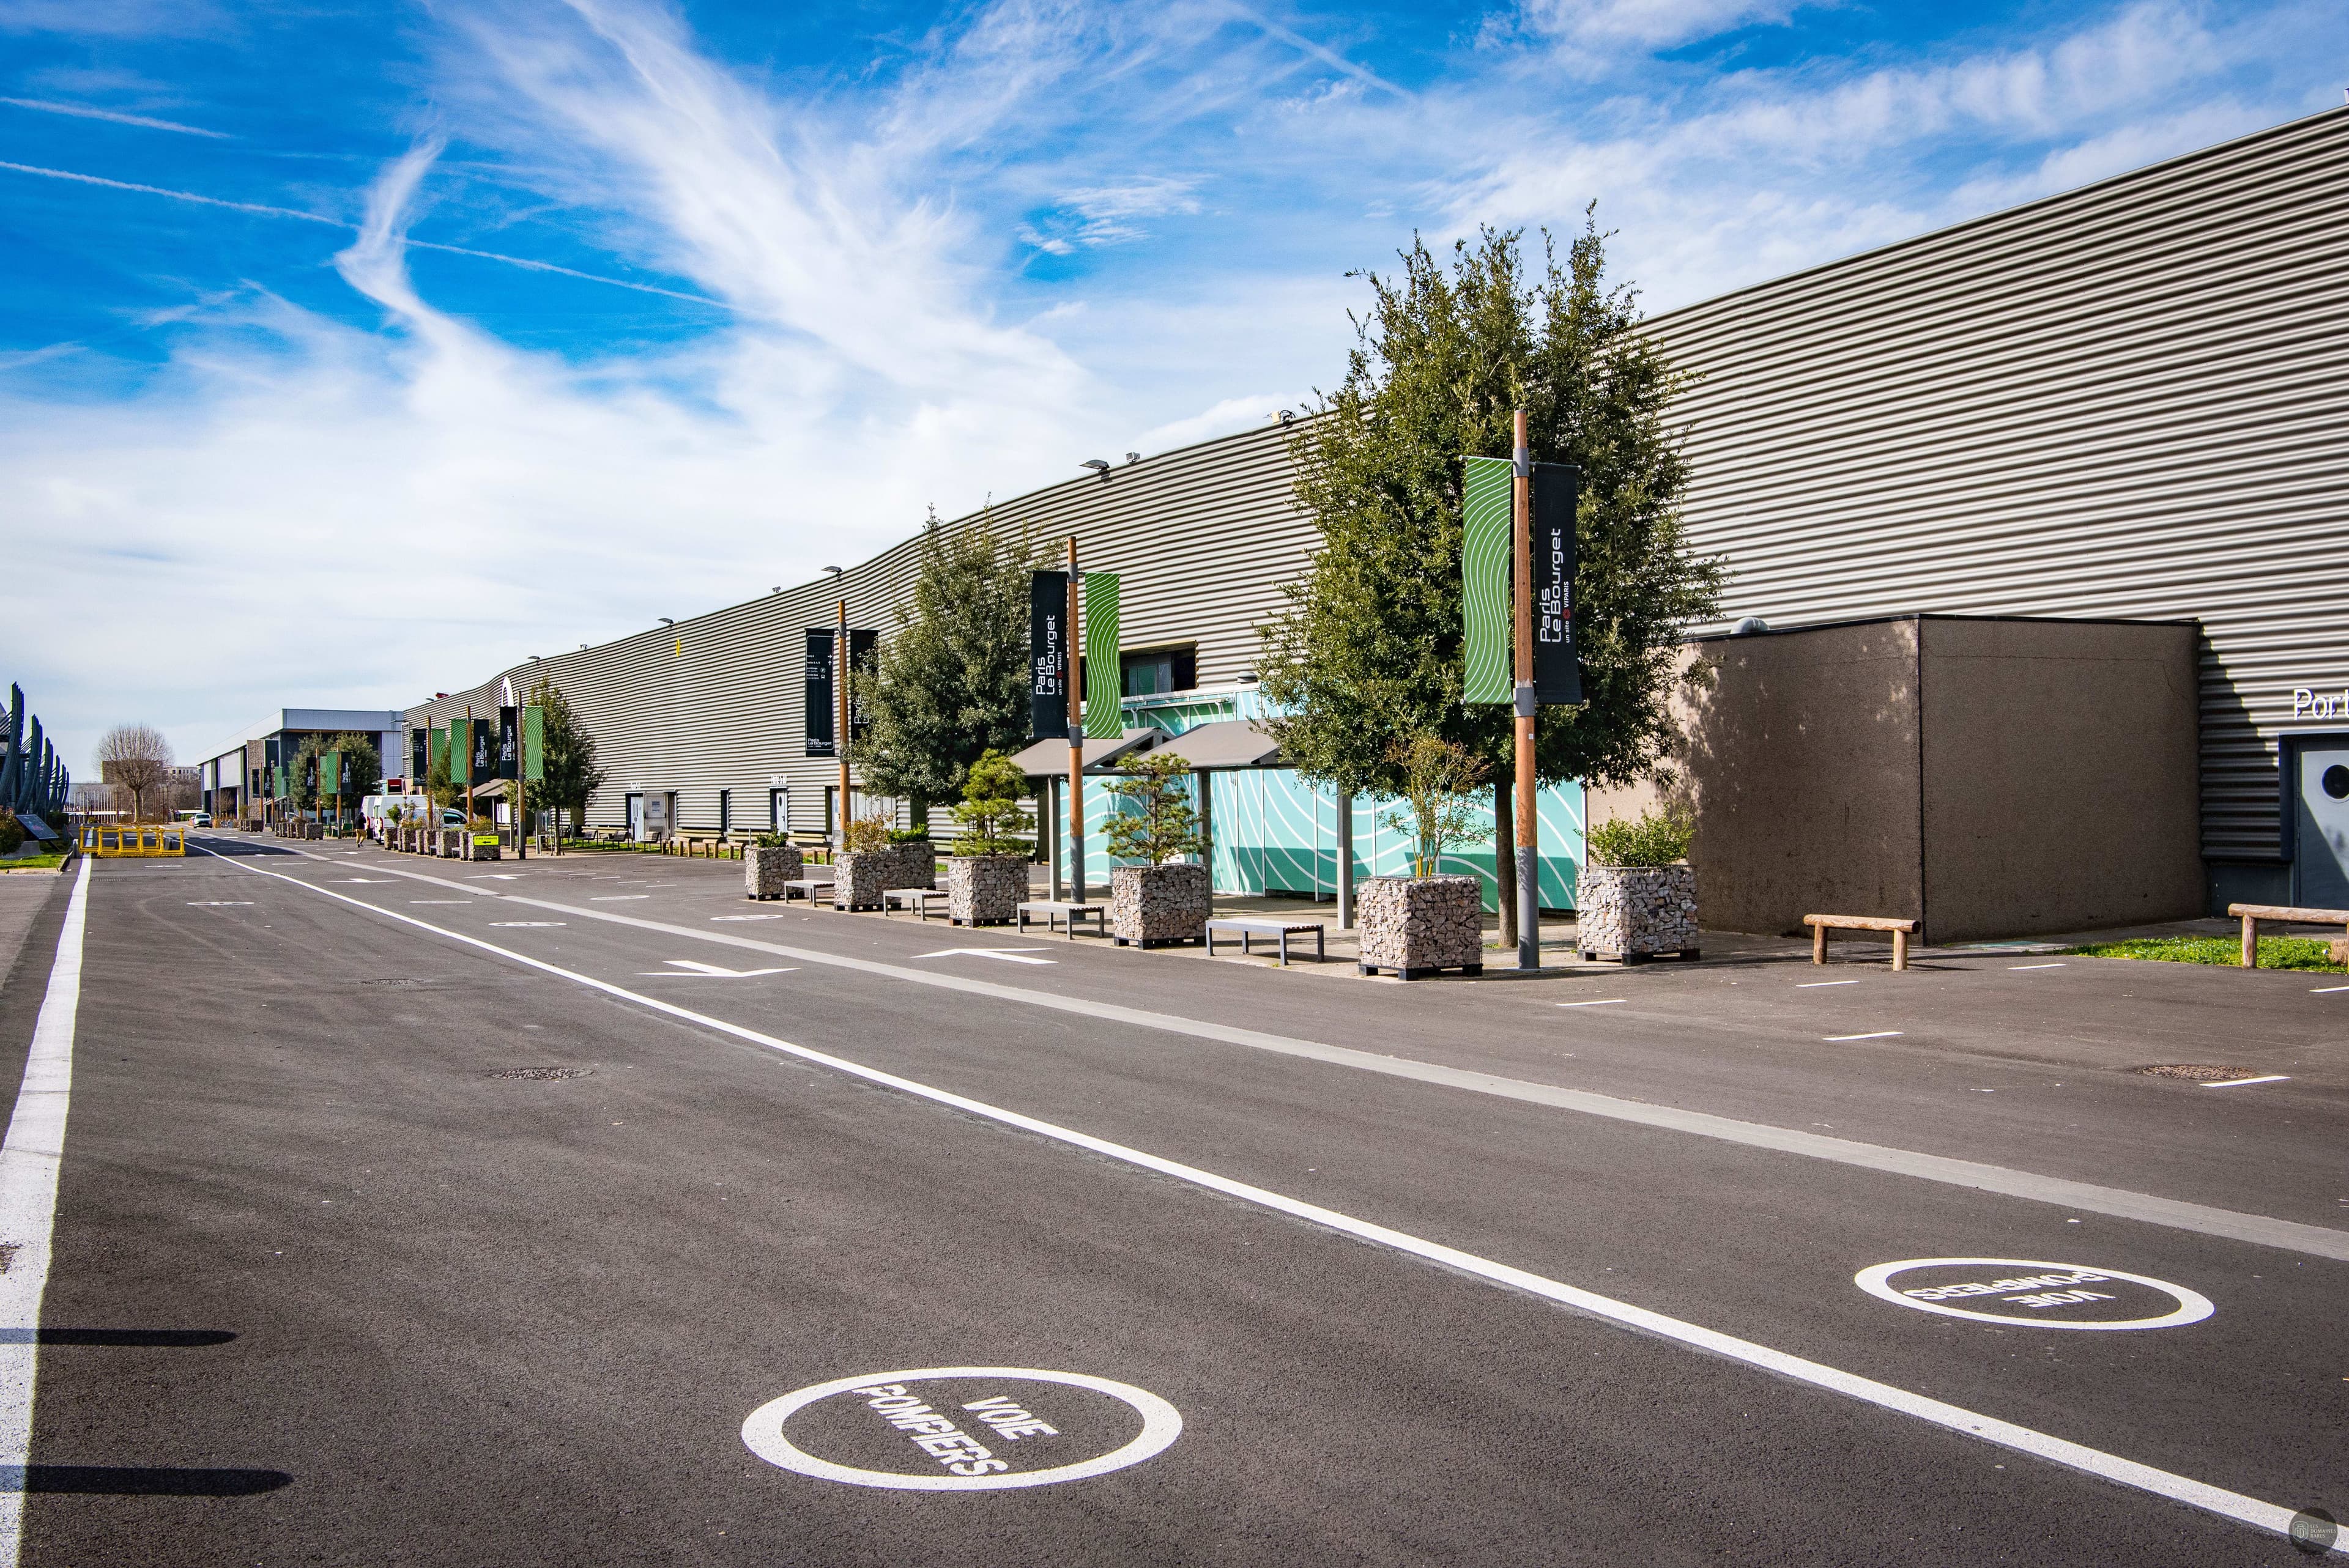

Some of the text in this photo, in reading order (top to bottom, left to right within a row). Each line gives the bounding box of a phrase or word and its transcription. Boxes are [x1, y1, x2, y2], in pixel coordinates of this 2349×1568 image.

[1550, 528, 1564, 643] Le Bourget
[1540, 588, 1551, 643] Paris
[1565, 632, 1570, 643] un
[1036, 657, 1045, 695] Paris
[1046, 615, 1057, 695] Le Bourget
[1903, 1271, 2110, 1301] POMPIERS
[2002, 1290, 2116, 1308] VOIE
[852, 1384, 1009, 1476] POMPIERS
[962, 1396, 1059, 1440] VOIE
